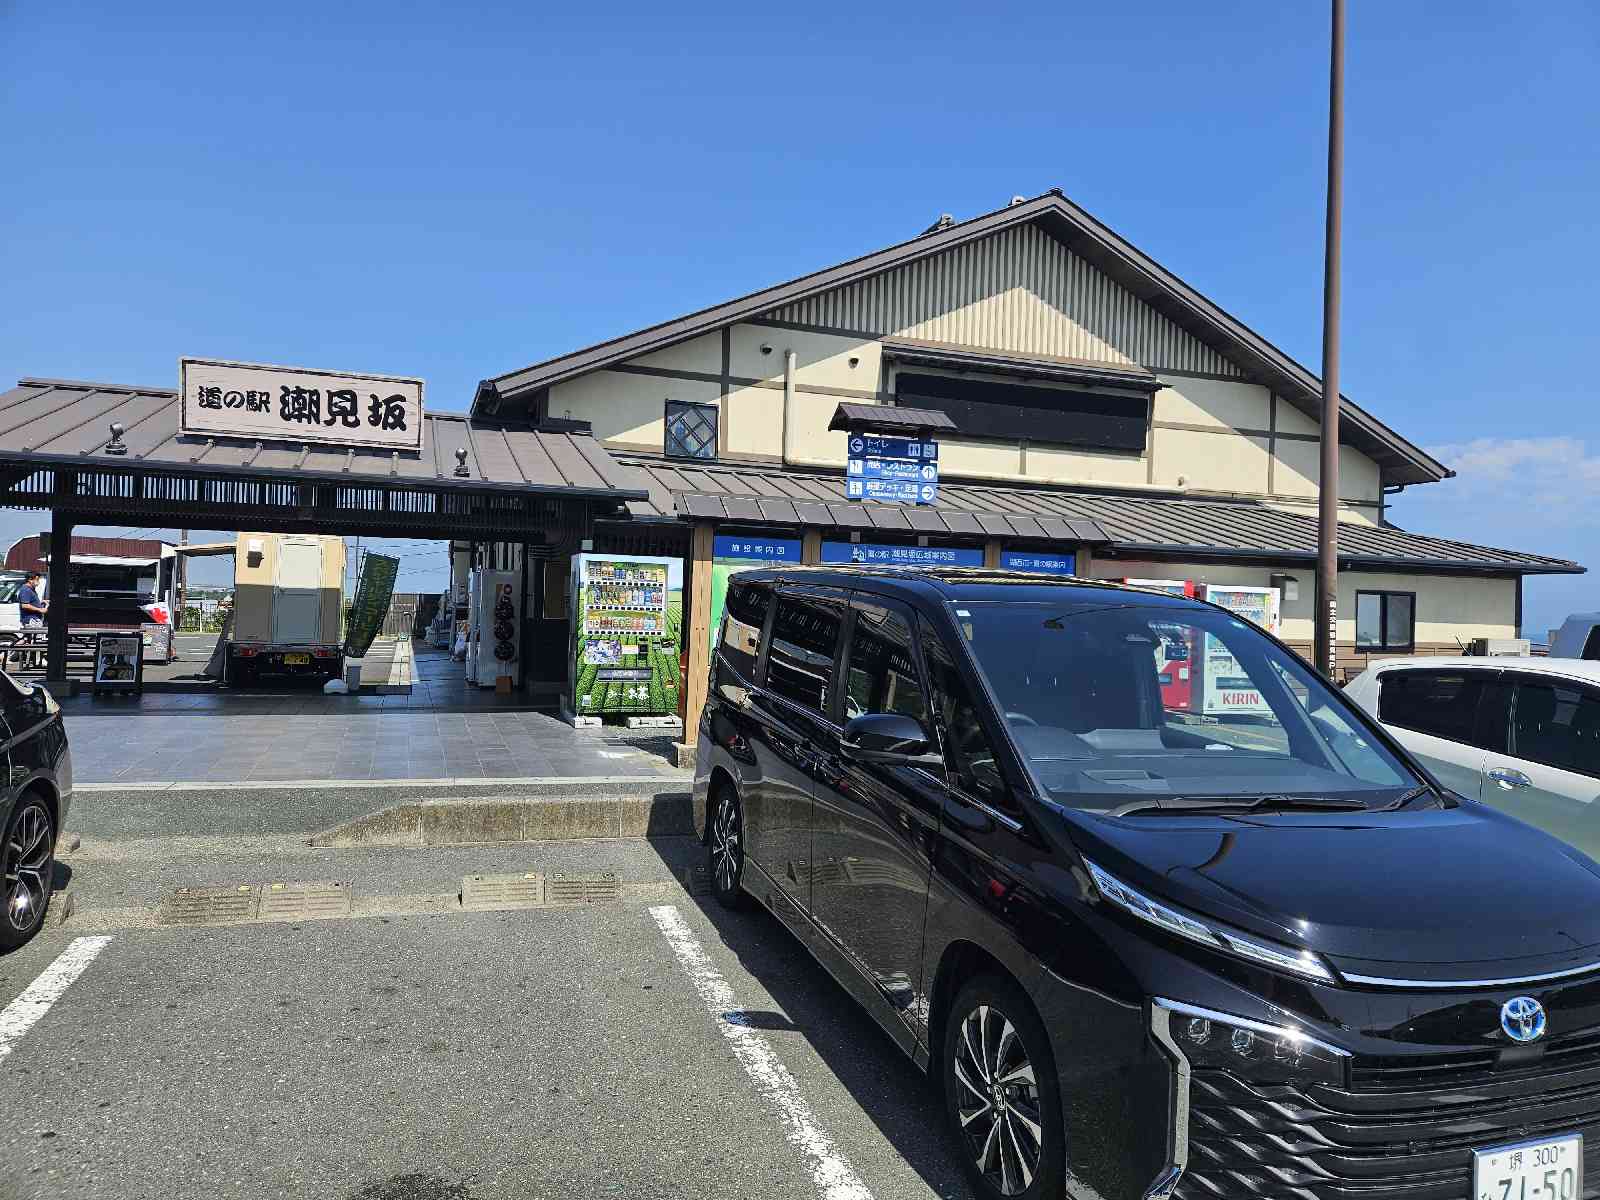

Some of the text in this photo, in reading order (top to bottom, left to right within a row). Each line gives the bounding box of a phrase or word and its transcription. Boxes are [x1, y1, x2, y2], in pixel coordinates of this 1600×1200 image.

[198, 385, 407, 432] 道の駅 潮見坂
[1222, 692, 1260, 705] KIRIN
[1533, 1146, 1559, 1167] 300
